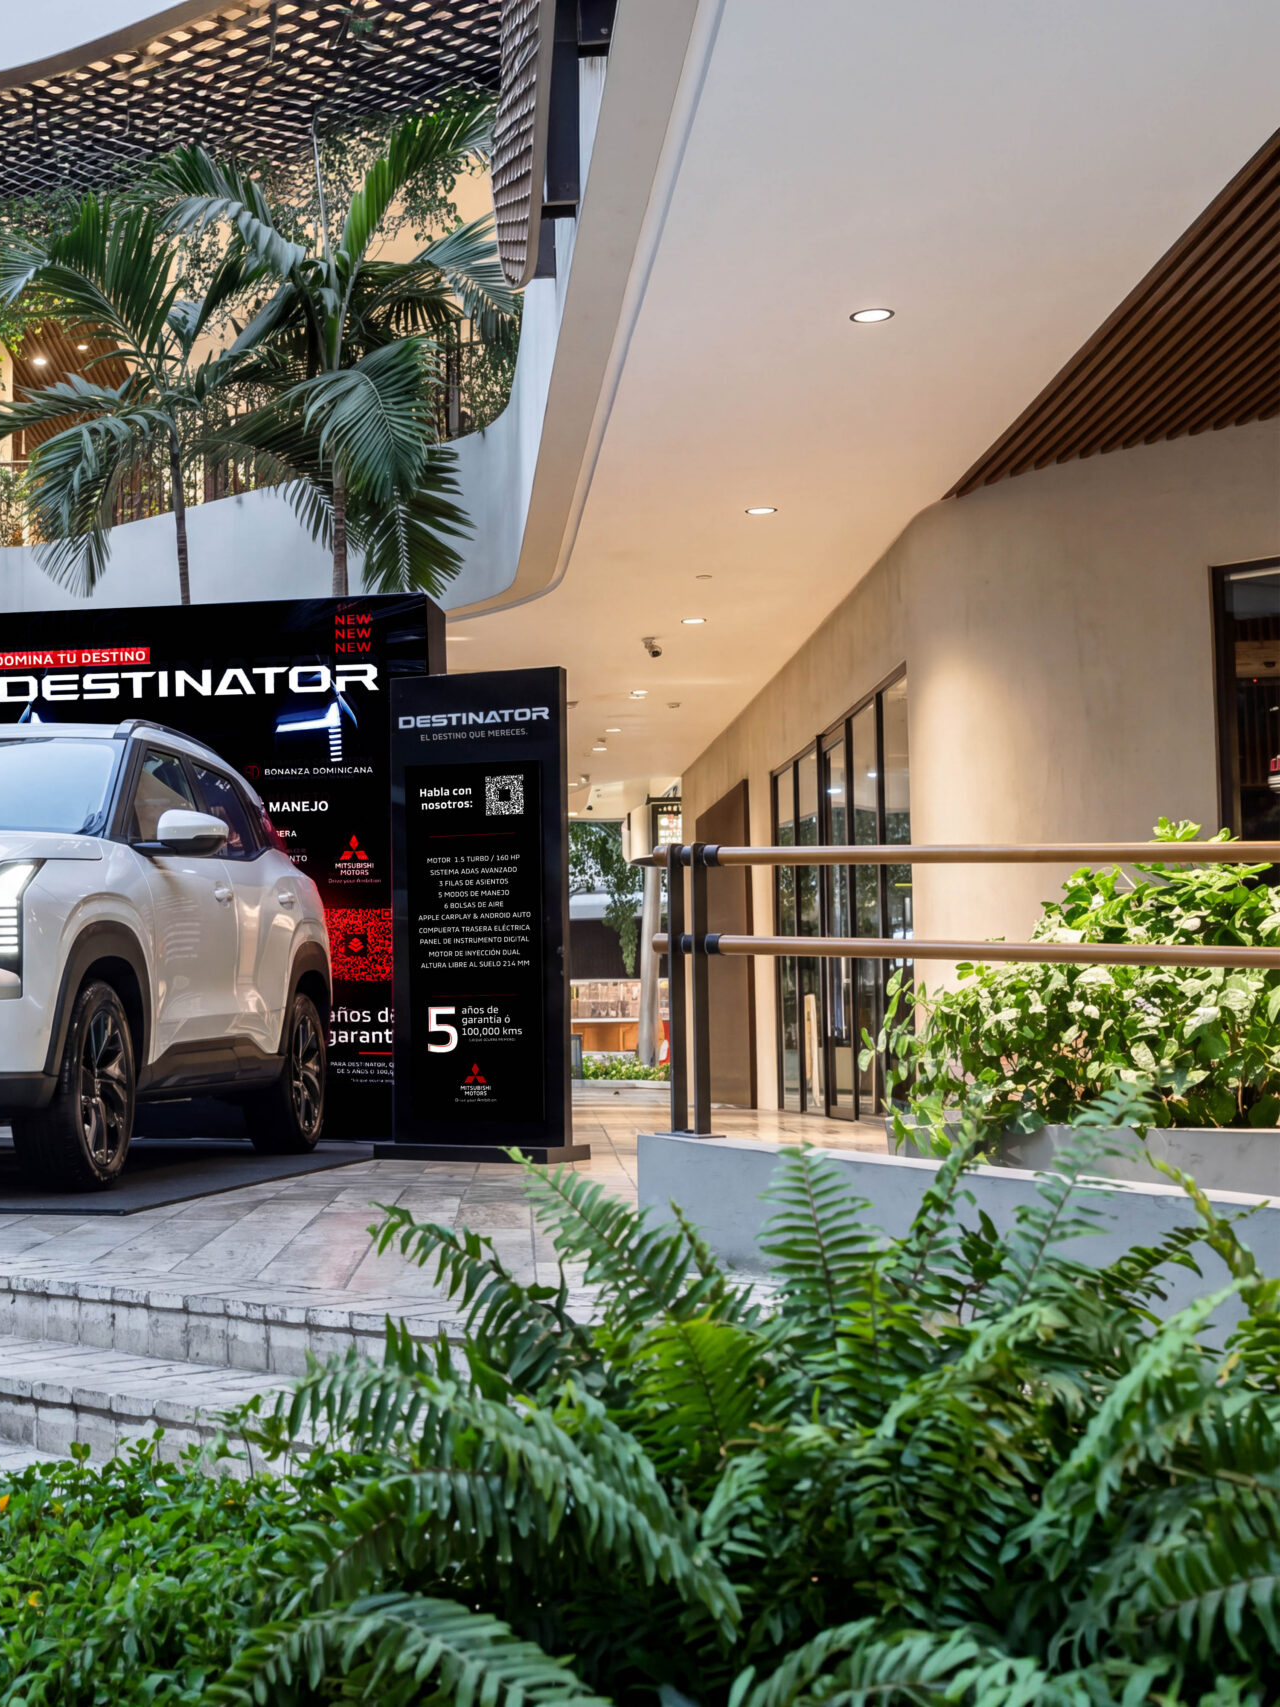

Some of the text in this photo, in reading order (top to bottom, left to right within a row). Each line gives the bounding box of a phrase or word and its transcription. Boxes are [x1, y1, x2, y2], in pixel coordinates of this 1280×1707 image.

[335, 614, 372, 625] NEW
[335, 628, 371, 639] NEW
[336, 642, 371, 653] NEW
[57, 653, 77, 664] TU
[81, 650, 146, 664] DESTINO
[399, 707, 549, 729] DESTINATOR
[420, 728, 527, 742] EL DESTINO QUE MERECES.
[420, 787, 449, 797] Habla
[269, 801, 328, 812] MANEJO
[422, 800, 472, 810] nosotros:
[462, 1006, 484, 1014] años
[462, 1015, 501, 1026] garantía
[428, 1007, 458, 1053] 5
[462, 1027, 500, 1037] 100,000
